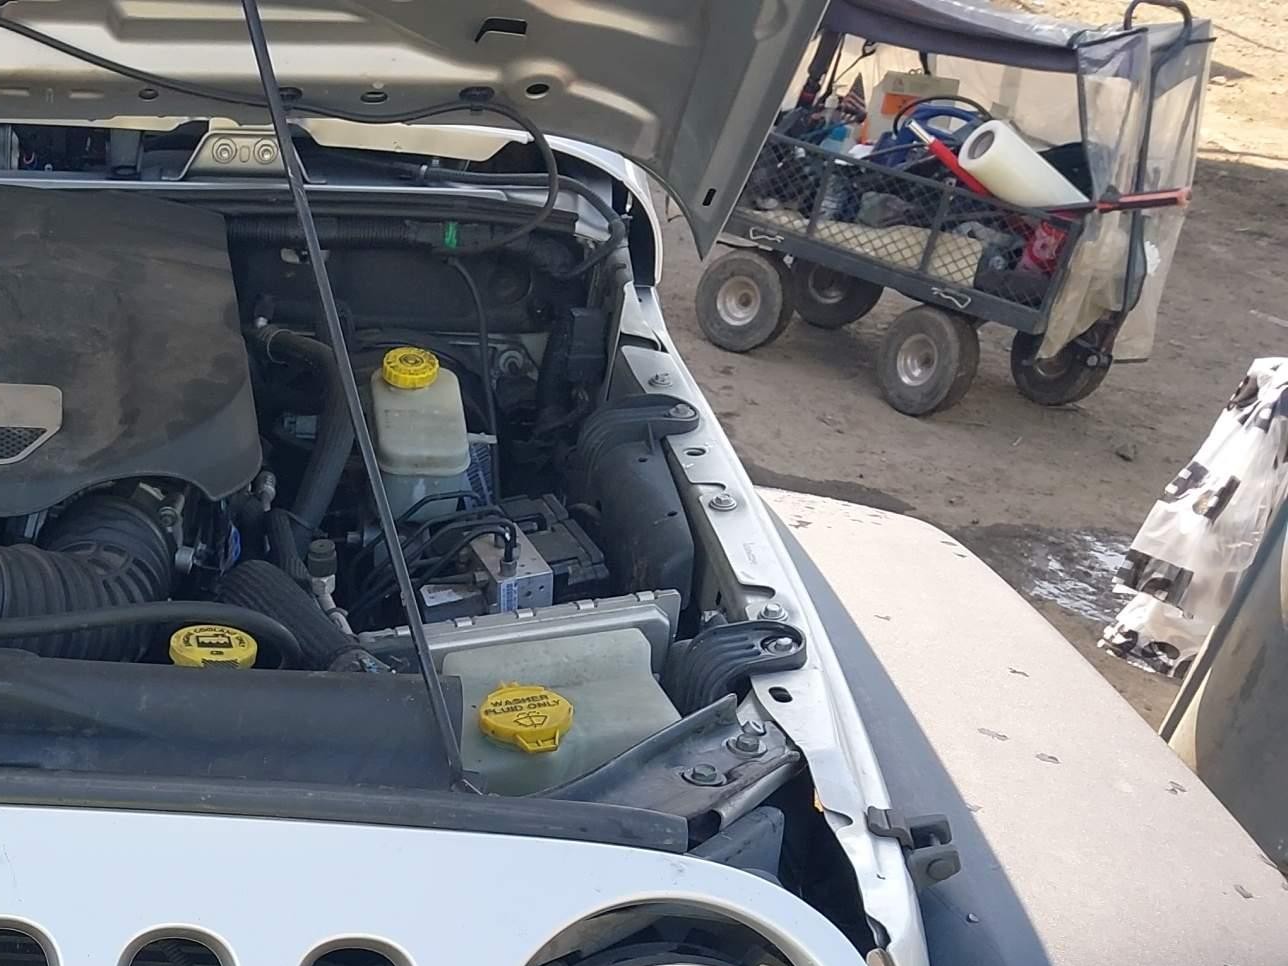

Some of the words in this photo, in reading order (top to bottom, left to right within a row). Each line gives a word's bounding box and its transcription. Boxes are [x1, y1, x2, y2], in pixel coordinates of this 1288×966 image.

[485, 704, 524, 715] FLUID
[527, 699, 560, 710] ONLY
[491, 694, 549, 707] WASHER
